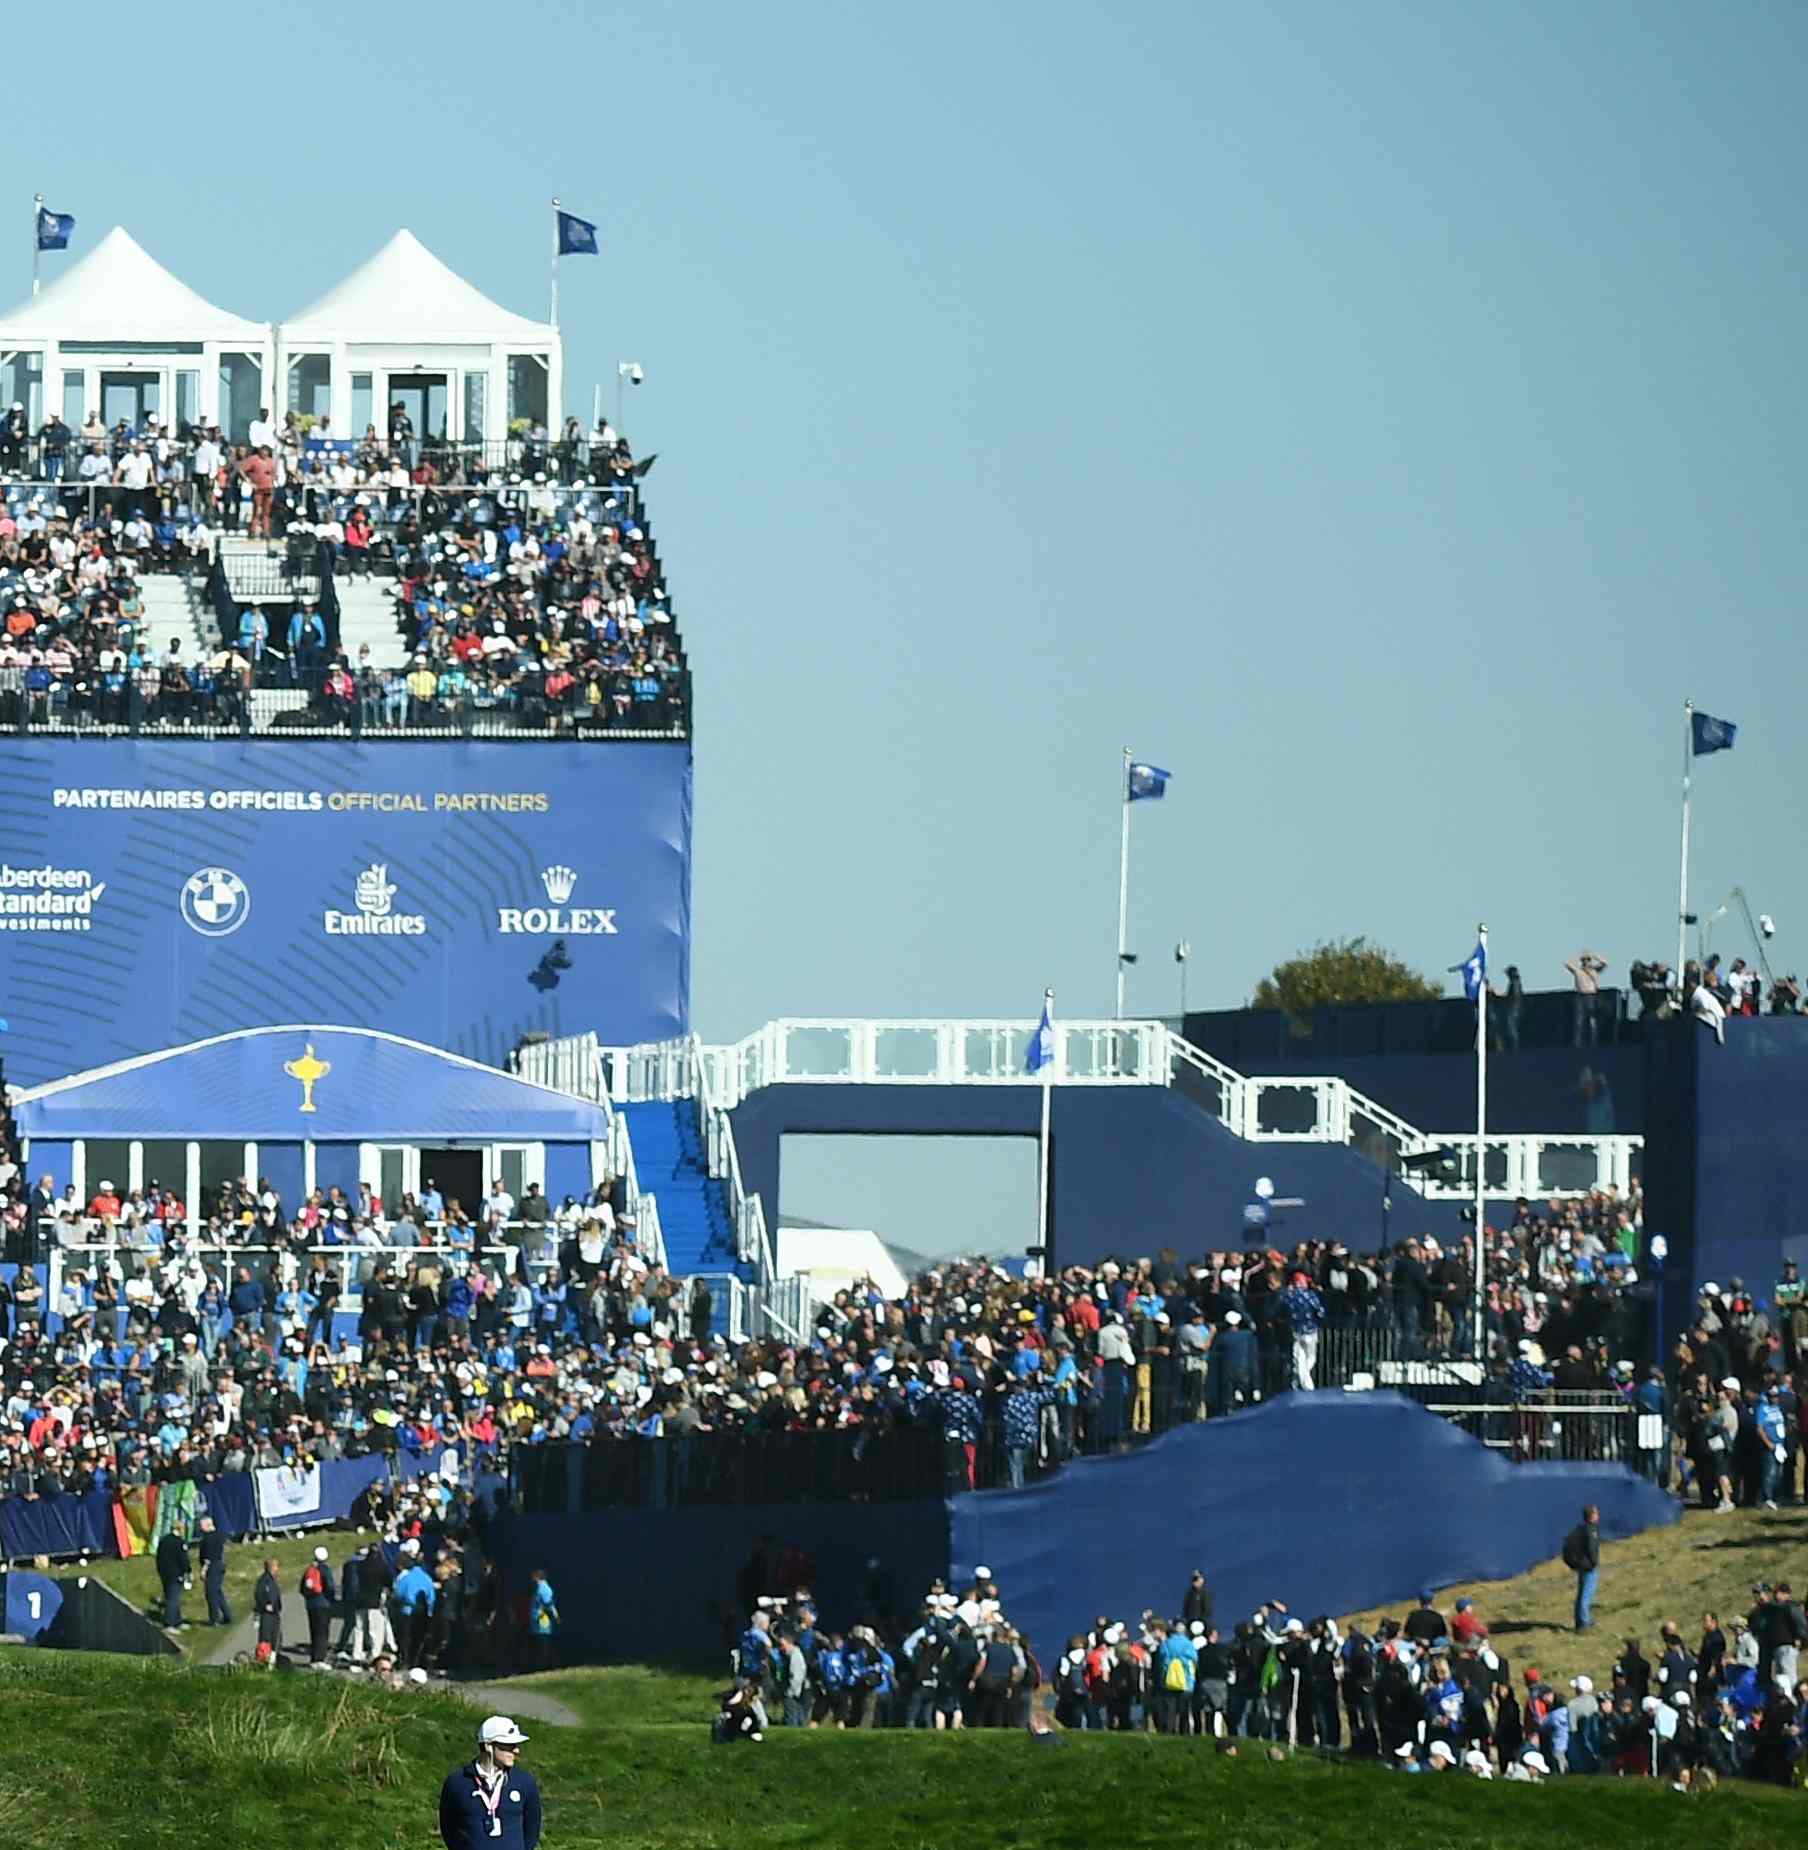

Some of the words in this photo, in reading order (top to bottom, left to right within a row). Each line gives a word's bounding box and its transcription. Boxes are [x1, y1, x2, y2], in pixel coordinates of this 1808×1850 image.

[53, 789, 206, 809] PARTENAIRES
[210, 791, 323, 810] OFFICIELS
[328, 792, 428, 812] OFFICIAL
[434, 793, 549, 813] PARTNERS
[324, 909, 426, 935] Emirates
[498, 908, 618, 934] ROLEX
[27, 1591, 41, 1620] 1
